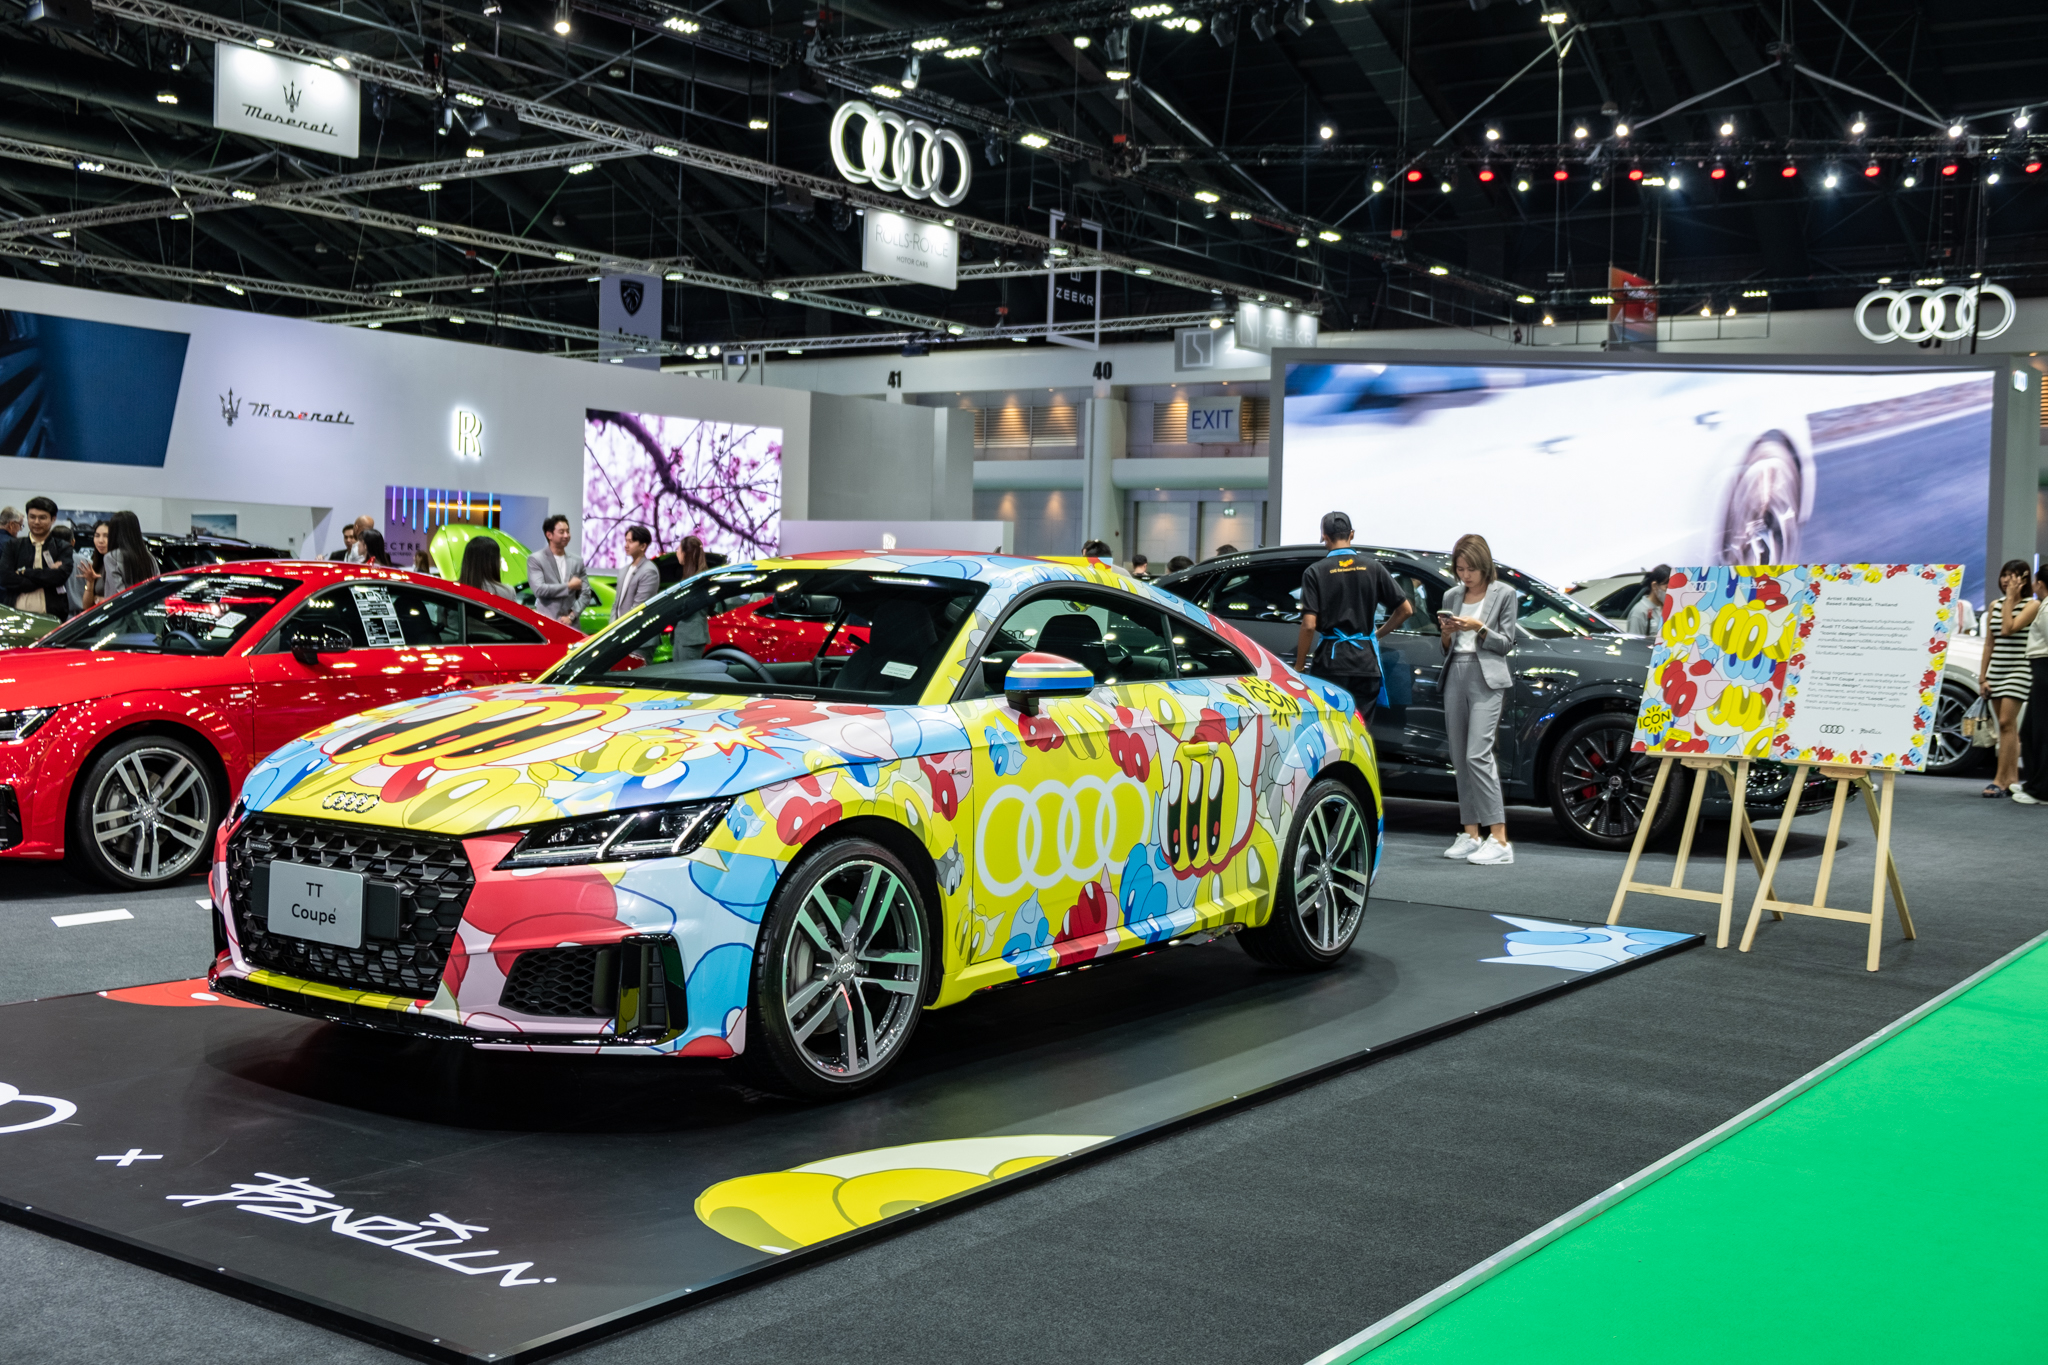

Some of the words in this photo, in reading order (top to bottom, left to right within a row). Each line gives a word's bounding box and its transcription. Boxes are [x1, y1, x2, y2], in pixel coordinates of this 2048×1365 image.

[242, 103, 338, 137] Maserati
[875, 224, 949, 258] ROLLS-ROYCE
[896, 256, 914, 266] MOTOR
[916, 260, 928, 268] CARS
[1056, 287, 1094, 306] ZEEKR
[1266, 324, 1313, 346] ZEEKR
[887, 370, 902, 388] 41
[1092, 361, 1112, 380] 40
[248, 402, 354, 424] Maserati
[1191, 409, 1234, 430] EXIT
[1240, 682, 1300, 716] ICON
[1638, 711, 1670, 728] ICON
[306, 882, 323, 898] TT
[291, 903, 336, 926] Coupé
